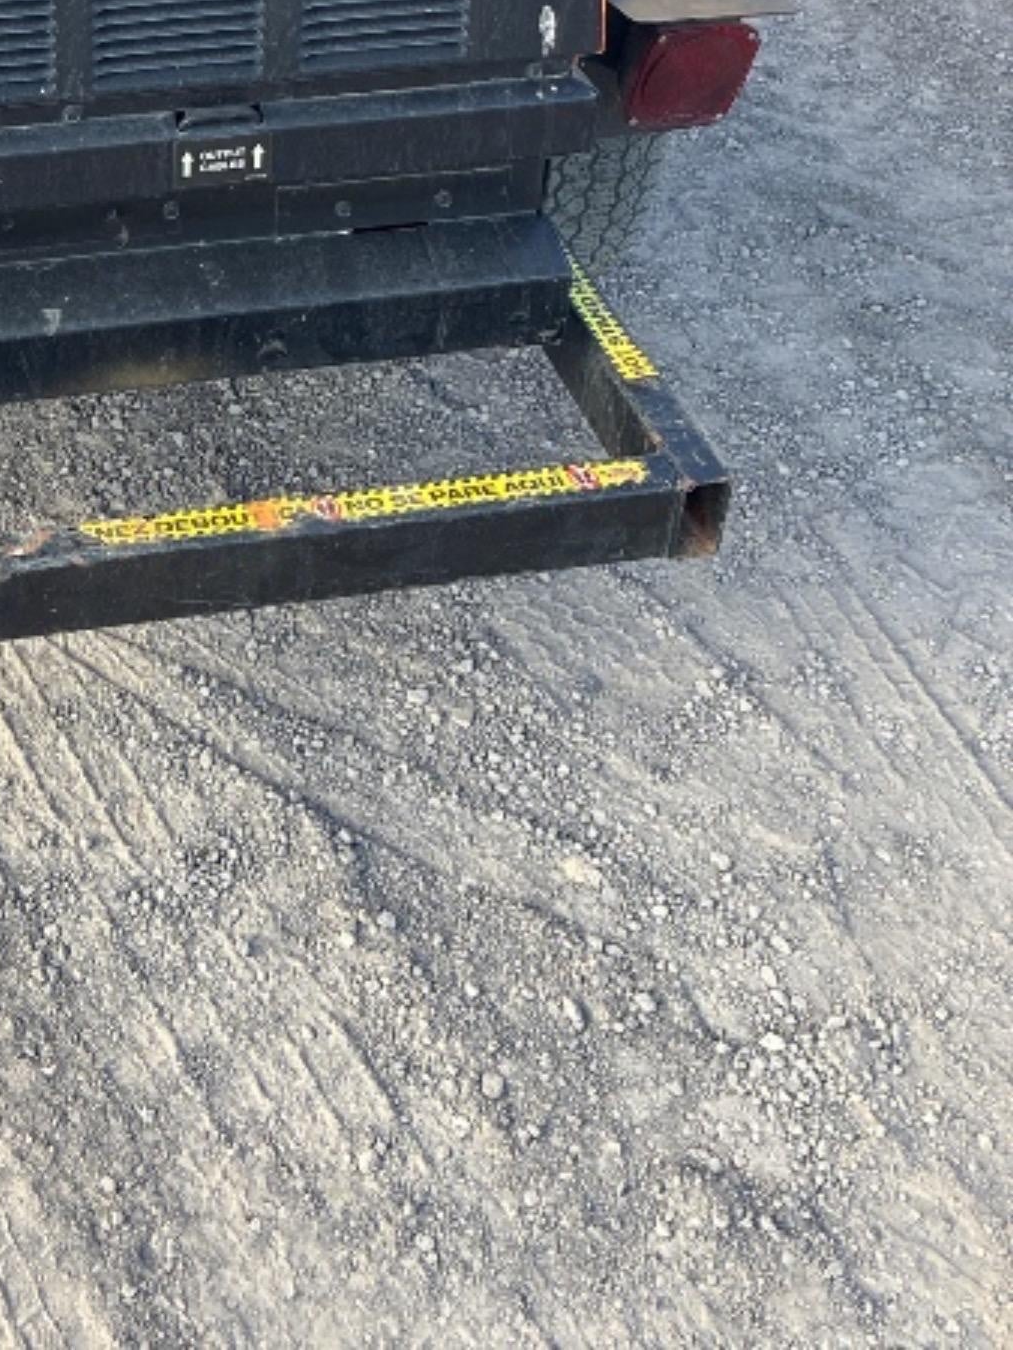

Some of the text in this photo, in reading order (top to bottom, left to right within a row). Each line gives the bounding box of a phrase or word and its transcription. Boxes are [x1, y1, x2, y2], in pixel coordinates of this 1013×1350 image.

[345, 496, 384, 514] NO
[429, 481, 498, 504] PARE
[504, 474, 564, 494] AQUI
